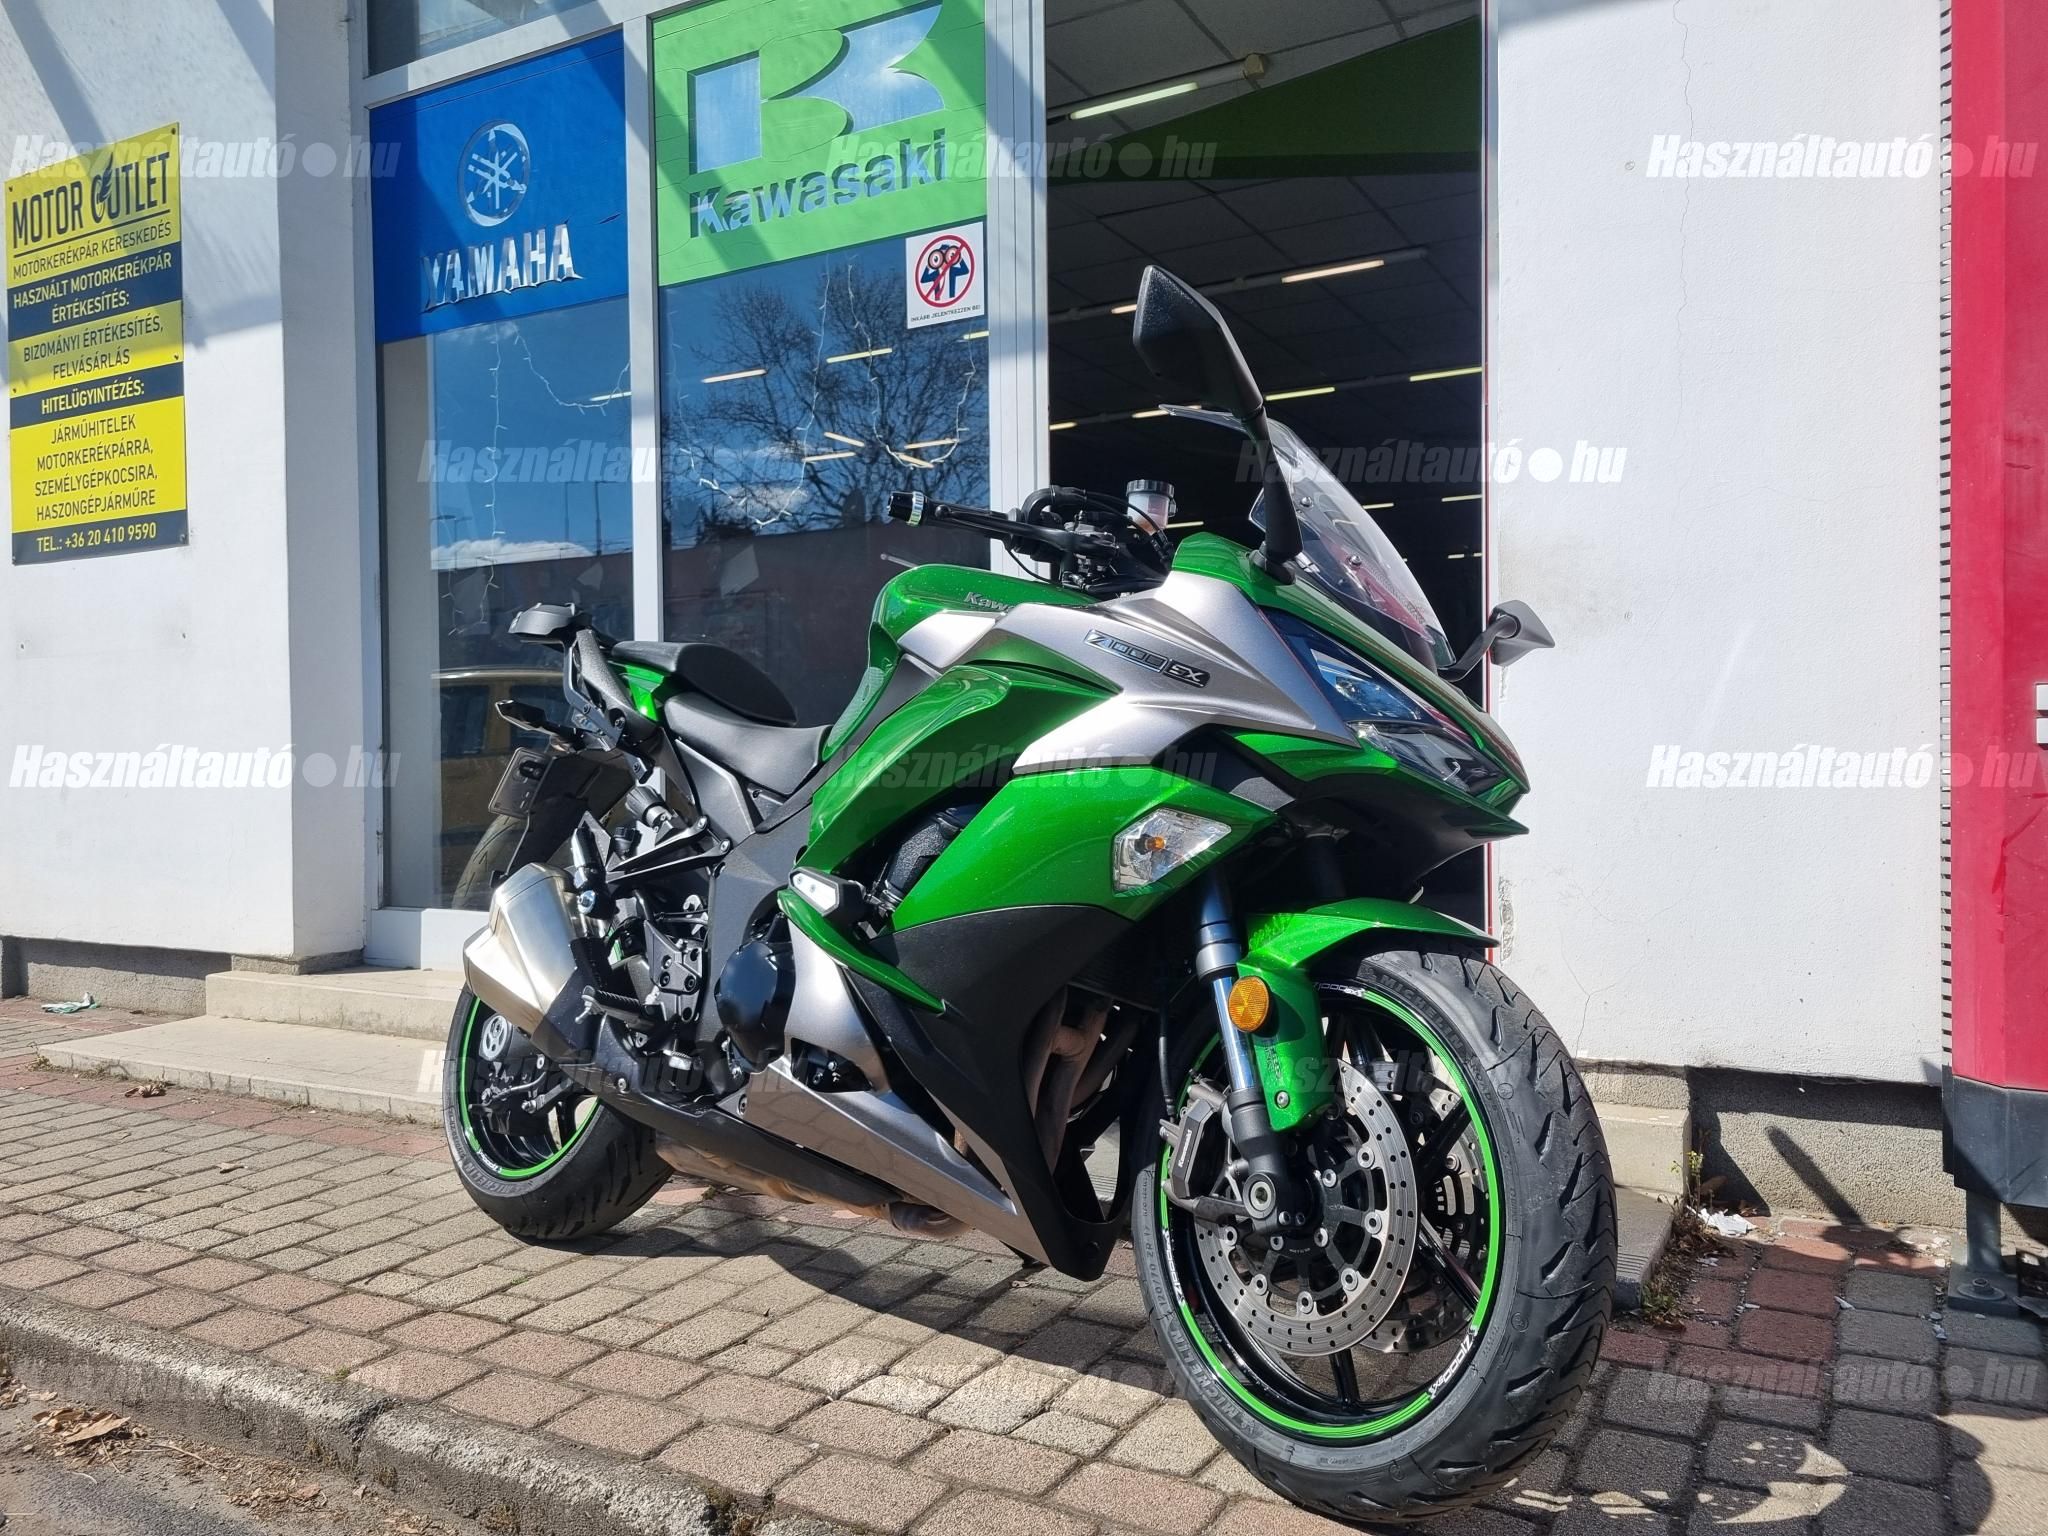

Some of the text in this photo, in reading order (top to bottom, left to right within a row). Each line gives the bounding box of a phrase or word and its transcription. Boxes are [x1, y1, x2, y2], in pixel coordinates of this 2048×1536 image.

[13, 151, 170, 249] MOTOR OUTLET
[690, 128, 947, 237] Kawasaki
[13, 219, 171, 280] MOTORKERÉKPÁR KERESKEDÉS
[421, 223, 576, 308] YAMAHA
[14, 249, 172, 309] HASZNÁLT MOTORKERÉKPÁR
[52, 287, 130, 324] ÉRTÉKESÍTÉS:
[24, 311, 164, 362] BIZOMÁNYI ÉRTÉKESÍTÉS,
[53, 346, 130, 380] FELVÁSÁRLÁS
[41, 376, 145, 414] HITELÜGYINTÉZÉS:
[51, 413, 136, 445] JÁRMŰHITELEK
[37, 437, 154, 472] MOTORKERÉKPÁRRA,
[35, 463, 158, 497] SZEMÉLYGÉPKOCSIRA,
[37, 487, 156, 522] HASZONGÉPJÁRMŰRE
[37, 521, 157, 553] TEL.: +36 20 410 9590
[1086, 632, 1166, 670] Z1000
[1171, 1327, 1245, 1426] MICHELIN
